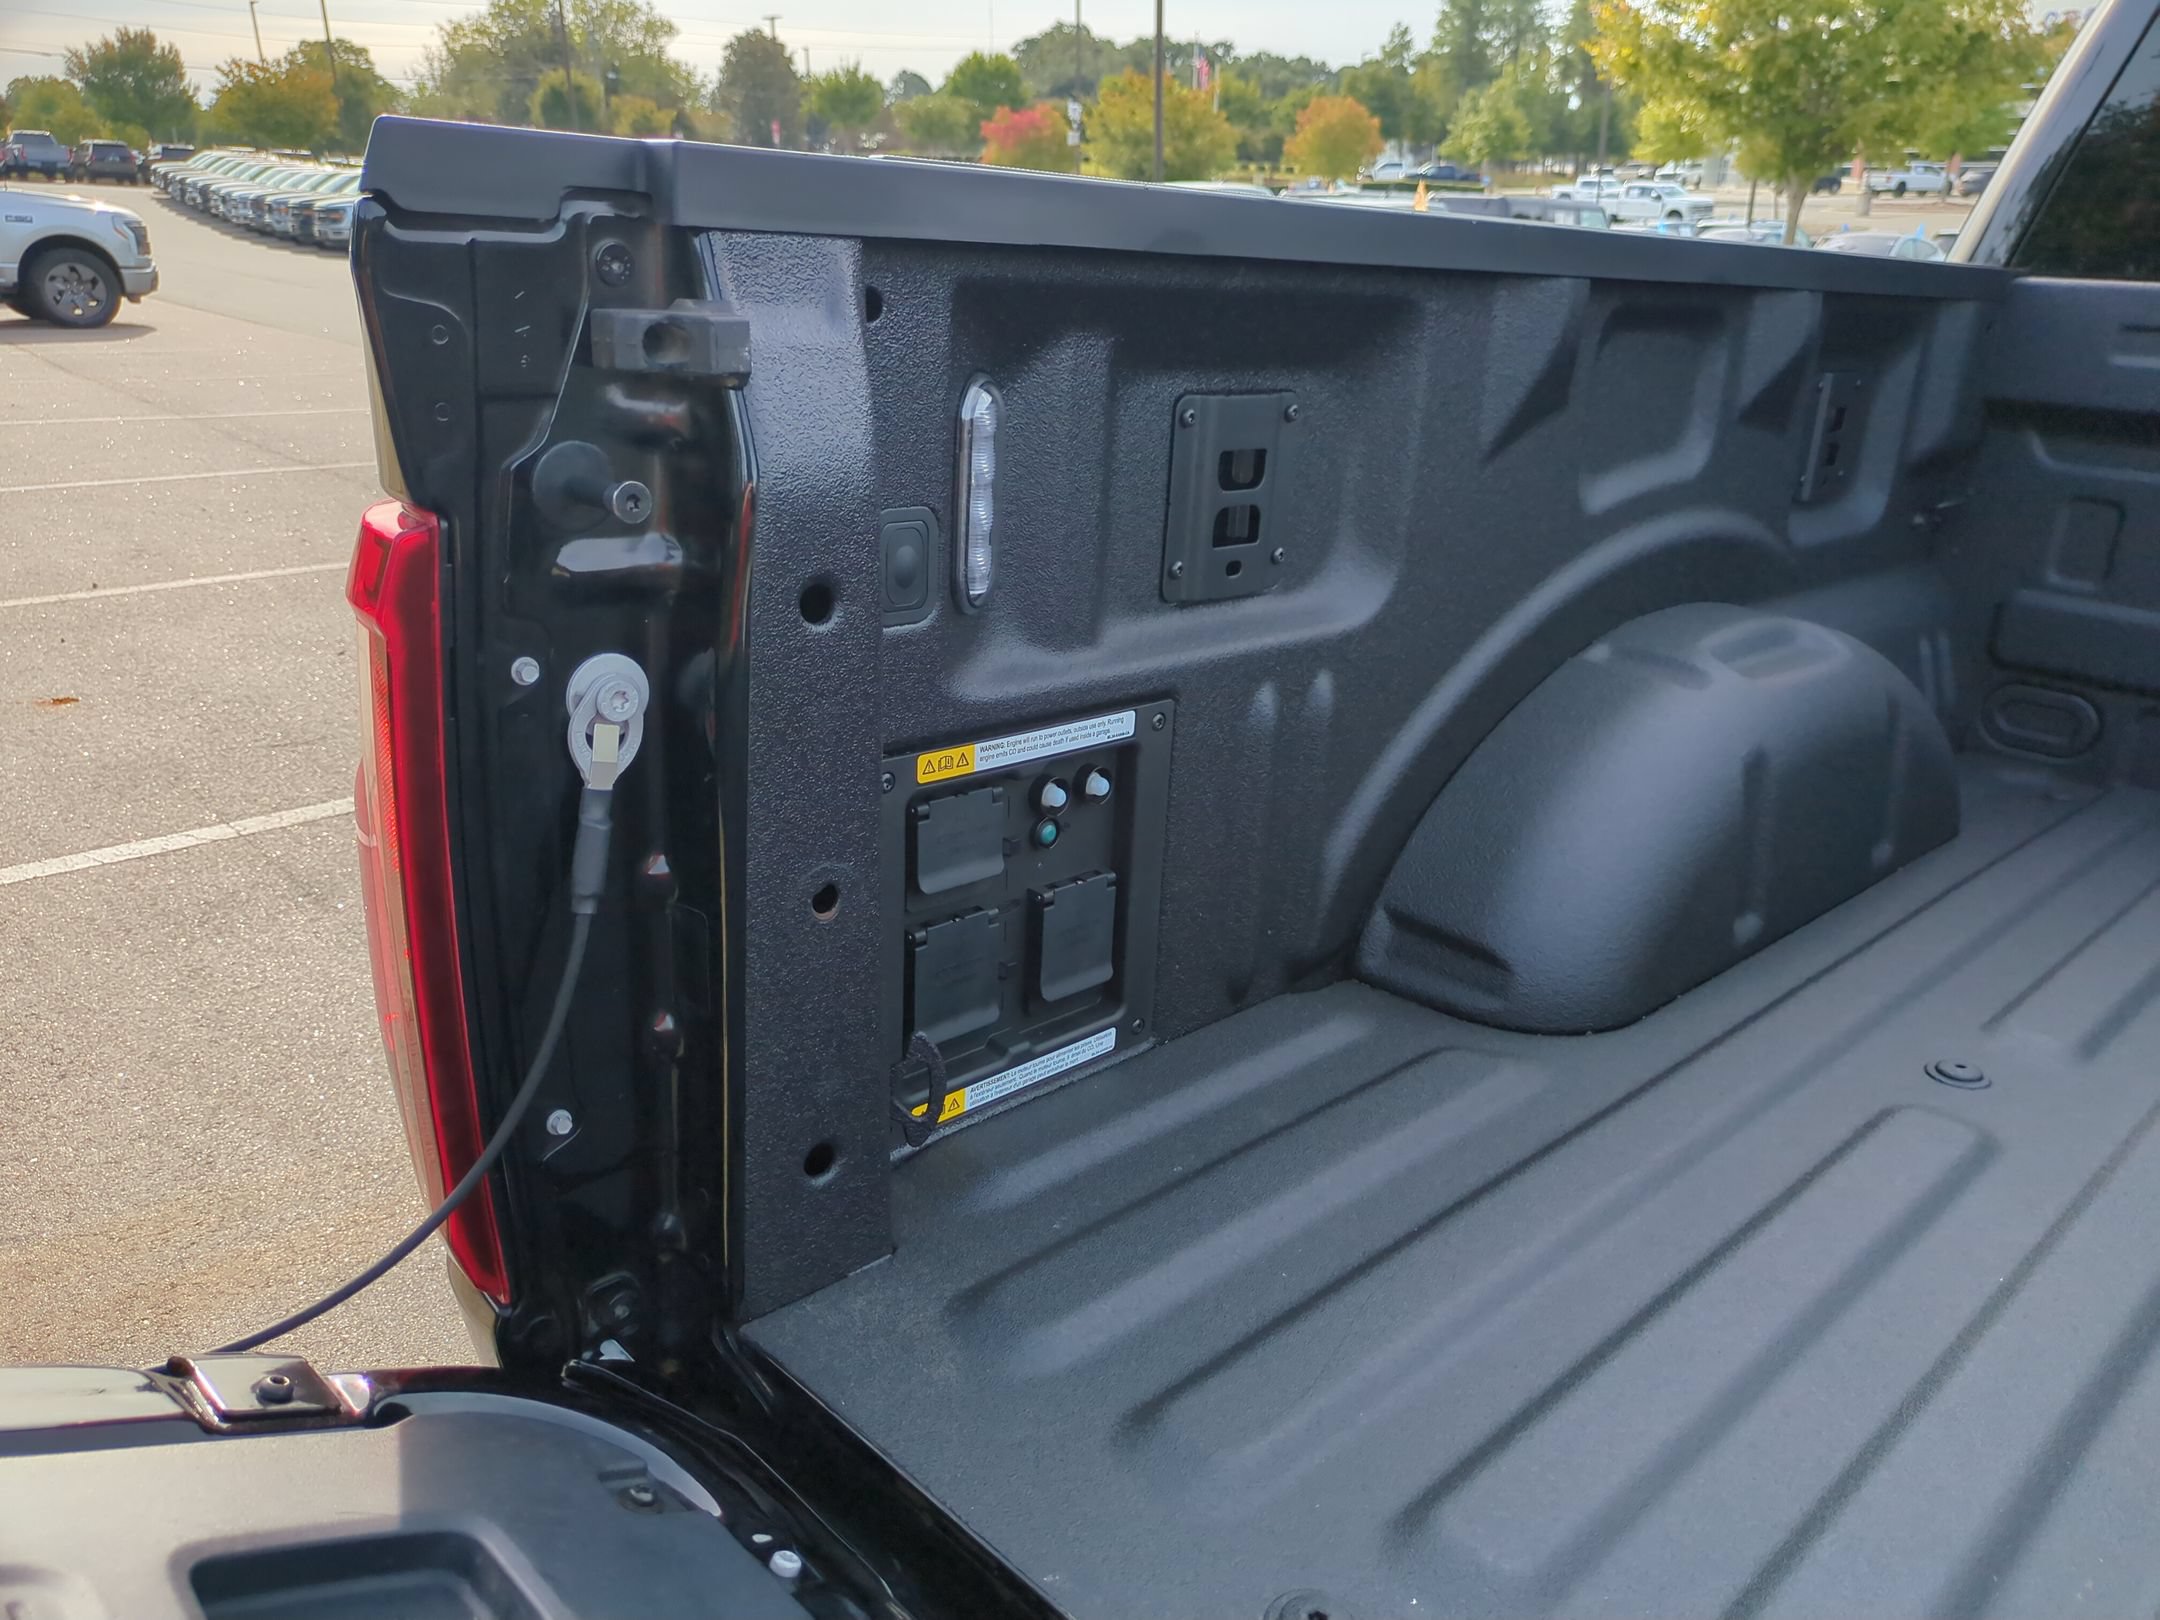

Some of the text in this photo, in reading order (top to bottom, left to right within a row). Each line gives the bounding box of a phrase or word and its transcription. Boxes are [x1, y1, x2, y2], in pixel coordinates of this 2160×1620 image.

[980, 742, 1005, 752] WARNING:
[1006, 739, 1022, 748] Engine
[1022, 736, 1030, 744] will
[1044, 732, 1057, 740] power
[1107, 717, 1124, 725] Running
[980, 754, 995, 762] engine
[996, 750, 1008, 758] emits
[1026, 744, 1038, 752] could
[1052, 738, 1064, 746] death
